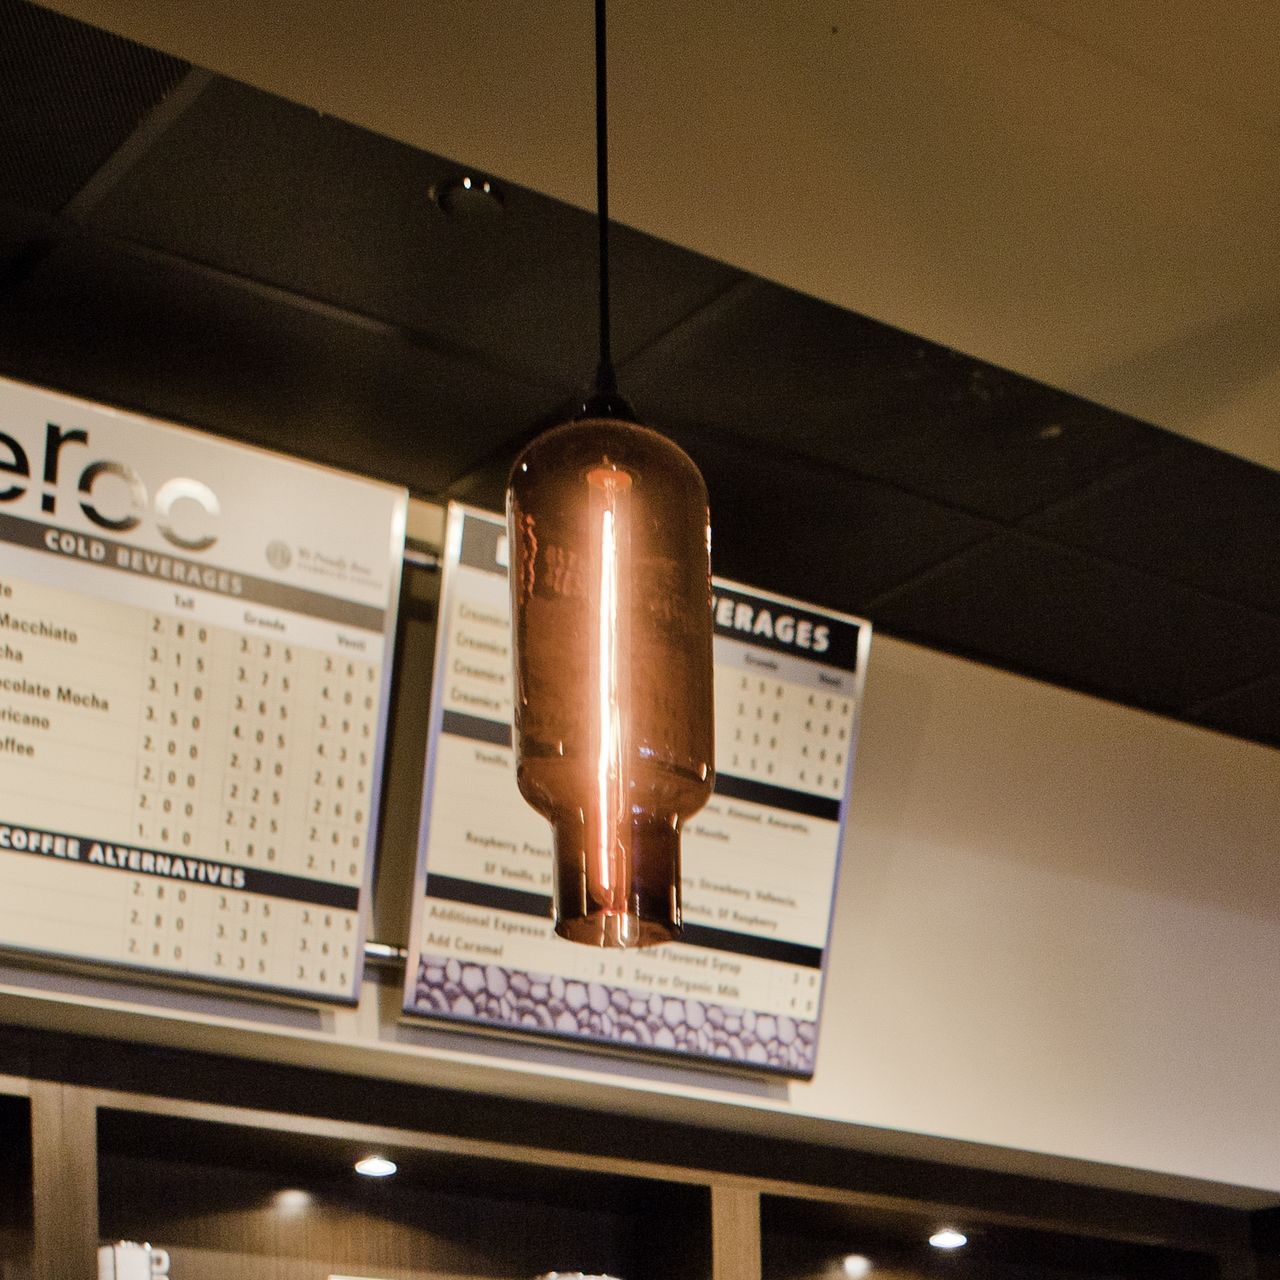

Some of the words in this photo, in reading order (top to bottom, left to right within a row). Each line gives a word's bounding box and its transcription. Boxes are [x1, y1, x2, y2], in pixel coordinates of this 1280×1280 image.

[44, 529, 106, 560] COLD
[116, 546, 243, 595] BEVERAGES
[712, 596, 830, 652] ERAGES
[56, 685, 110, 712] Mocha
[0, 826, 80, 860] COFFEE
[89, 842, 246, 888] ALTERNATIVES
